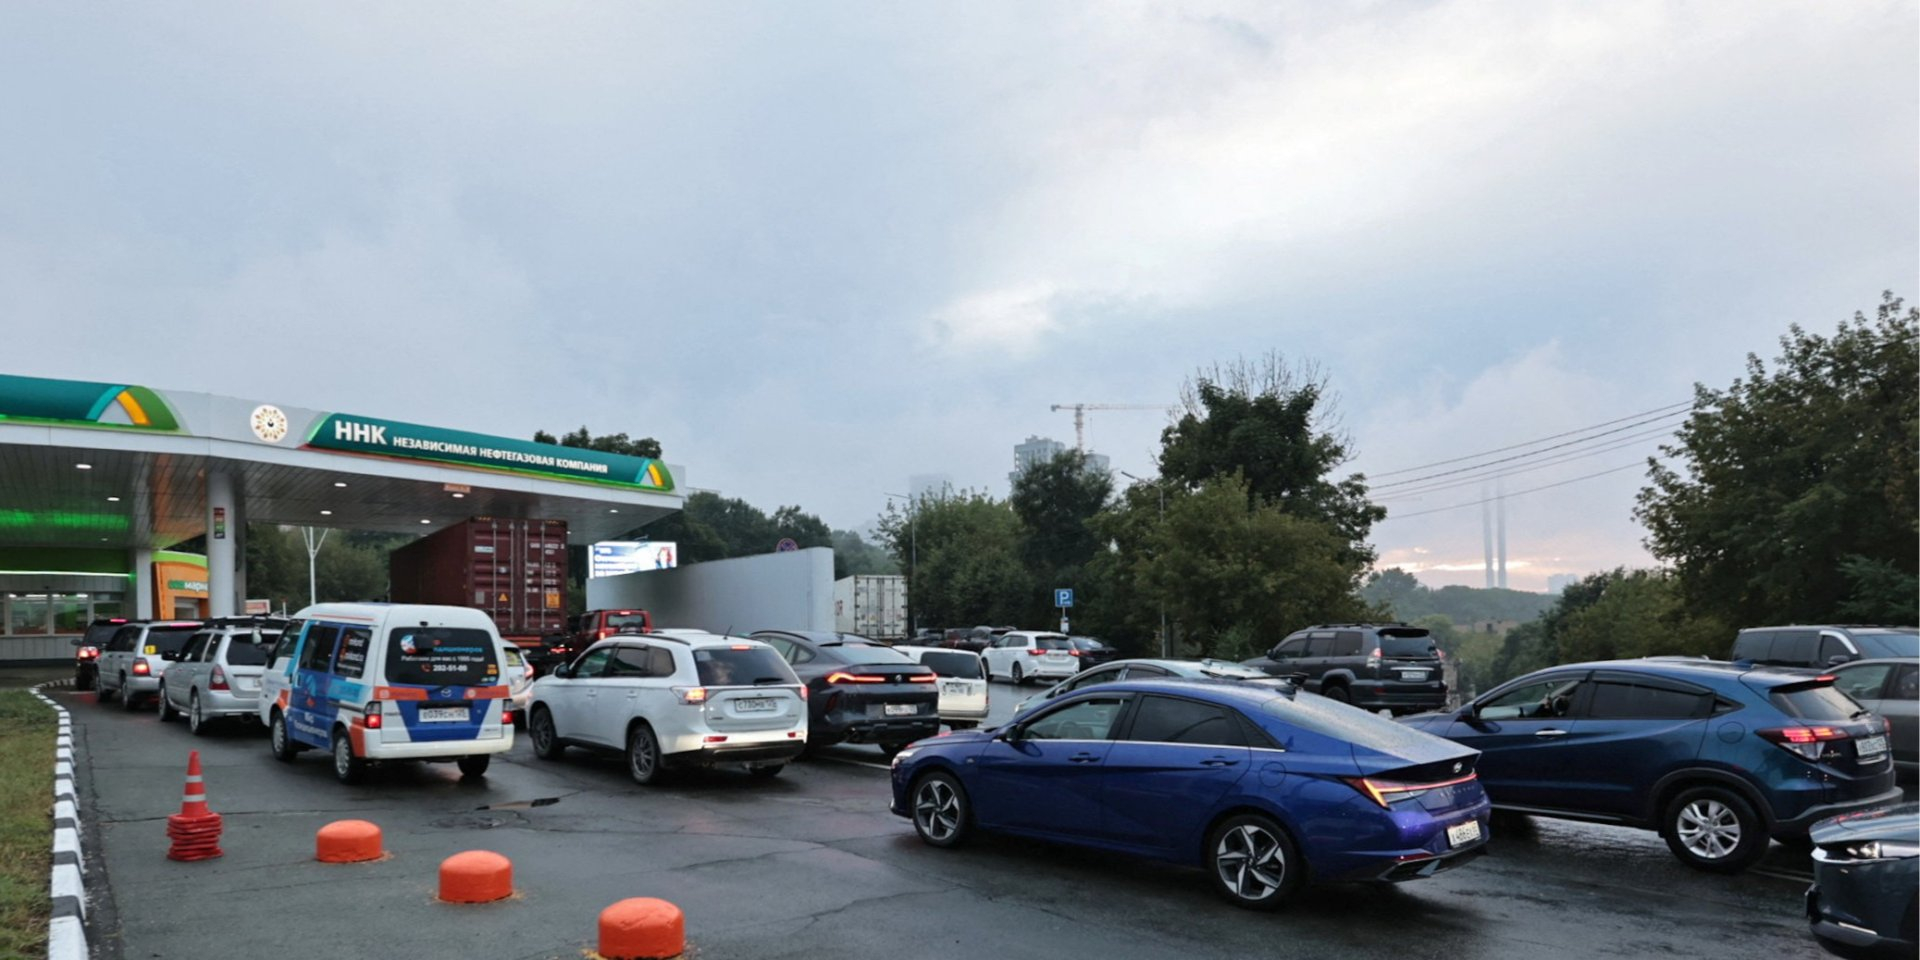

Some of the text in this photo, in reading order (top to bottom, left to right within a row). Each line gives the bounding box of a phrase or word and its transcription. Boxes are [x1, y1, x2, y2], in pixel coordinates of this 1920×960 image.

[334, 420, 608, 474] ННК НЕЗАВИСИМАЯ НЕФТЕГАЗОВАЯ КОМПАНИЯ
[1059, 591, 1069, 605] P
